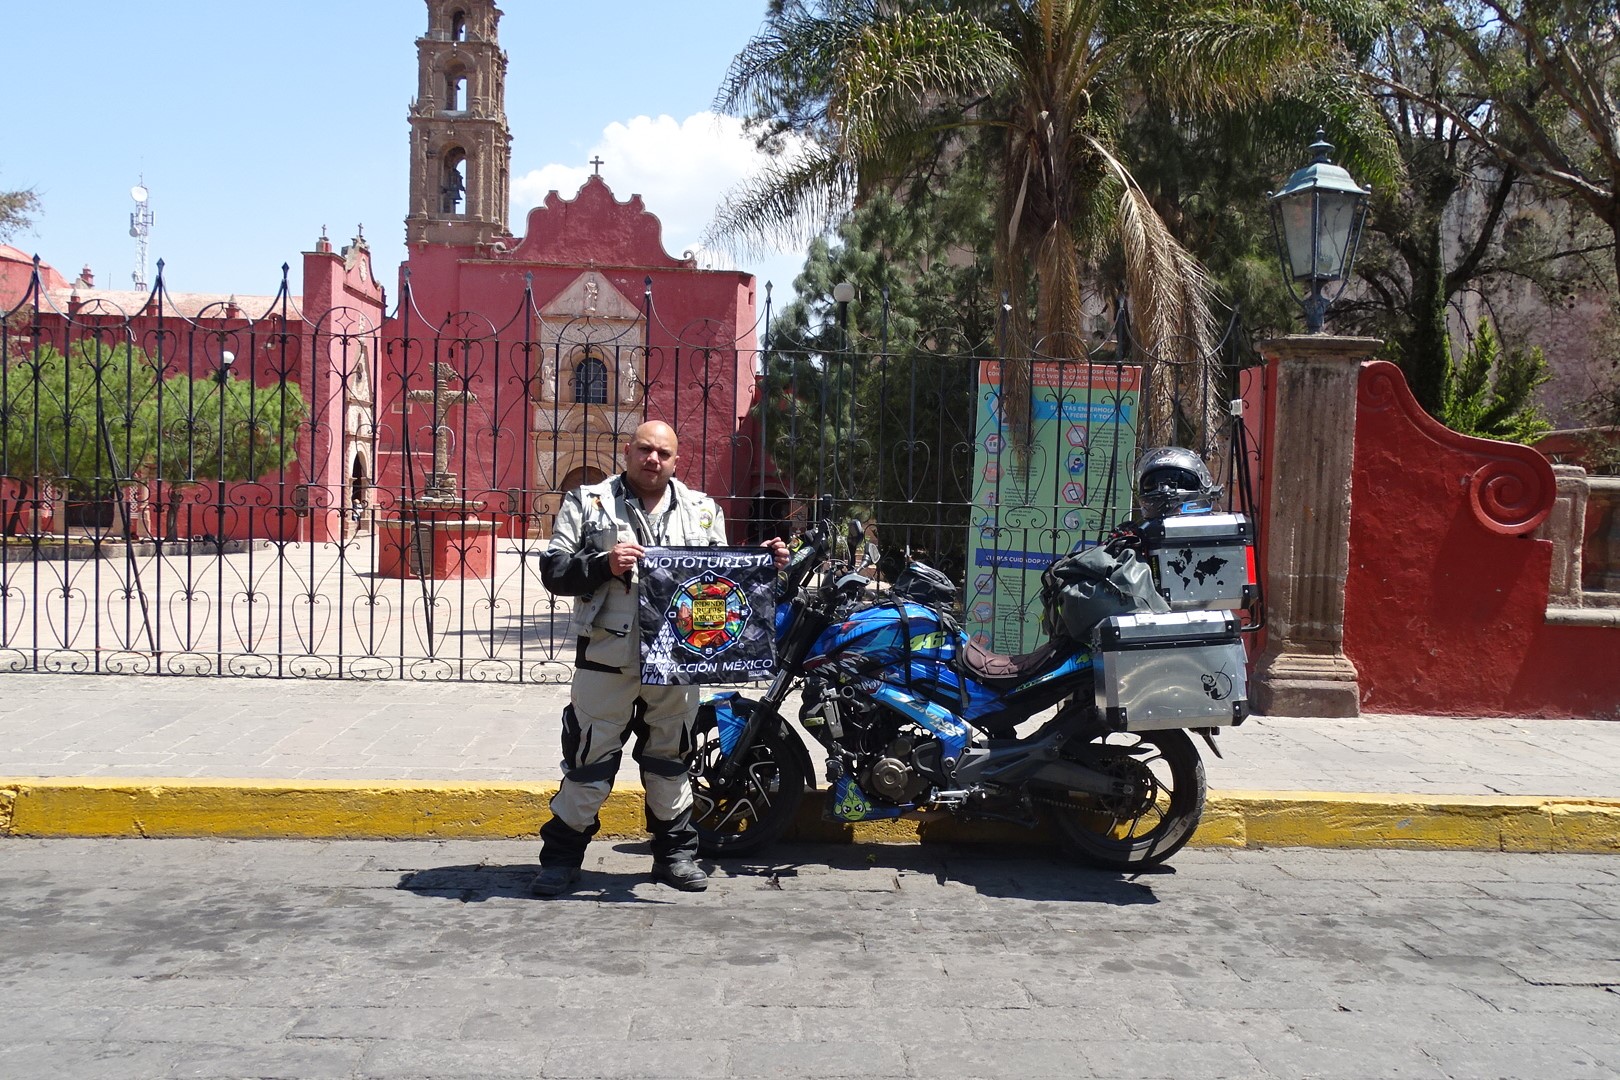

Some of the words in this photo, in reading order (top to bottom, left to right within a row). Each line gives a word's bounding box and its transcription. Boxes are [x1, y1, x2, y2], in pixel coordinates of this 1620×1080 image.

[643, 553, 773, 569] MOTOTURISTA
[901, 632, 947, 652] 46
[705, 647, 713, 655] S
[667, 661, 718, 673] ACCIÓN
[722, 659, 773, 672] MÉXICO
